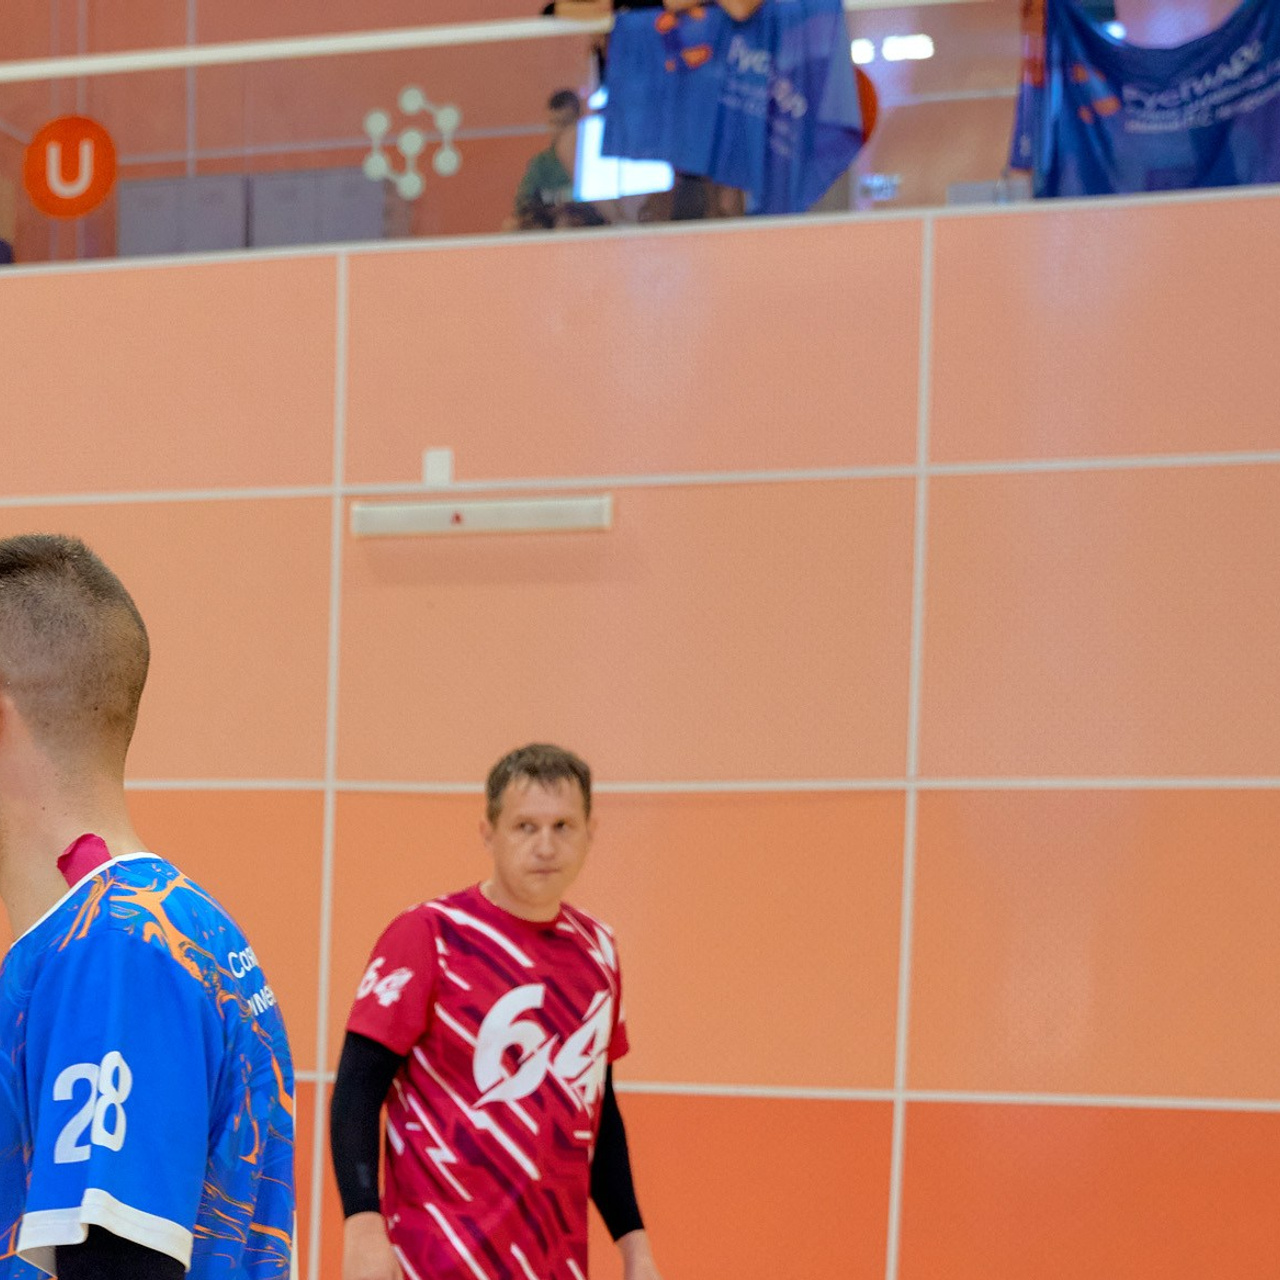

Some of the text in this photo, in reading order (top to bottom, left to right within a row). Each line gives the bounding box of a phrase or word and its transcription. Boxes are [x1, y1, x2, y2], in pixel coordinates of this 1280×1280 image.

[355, 956, 415, 1008] 64
[471, 983, 614, 1110] 64
[52, 1050, 134, 1165] 28
